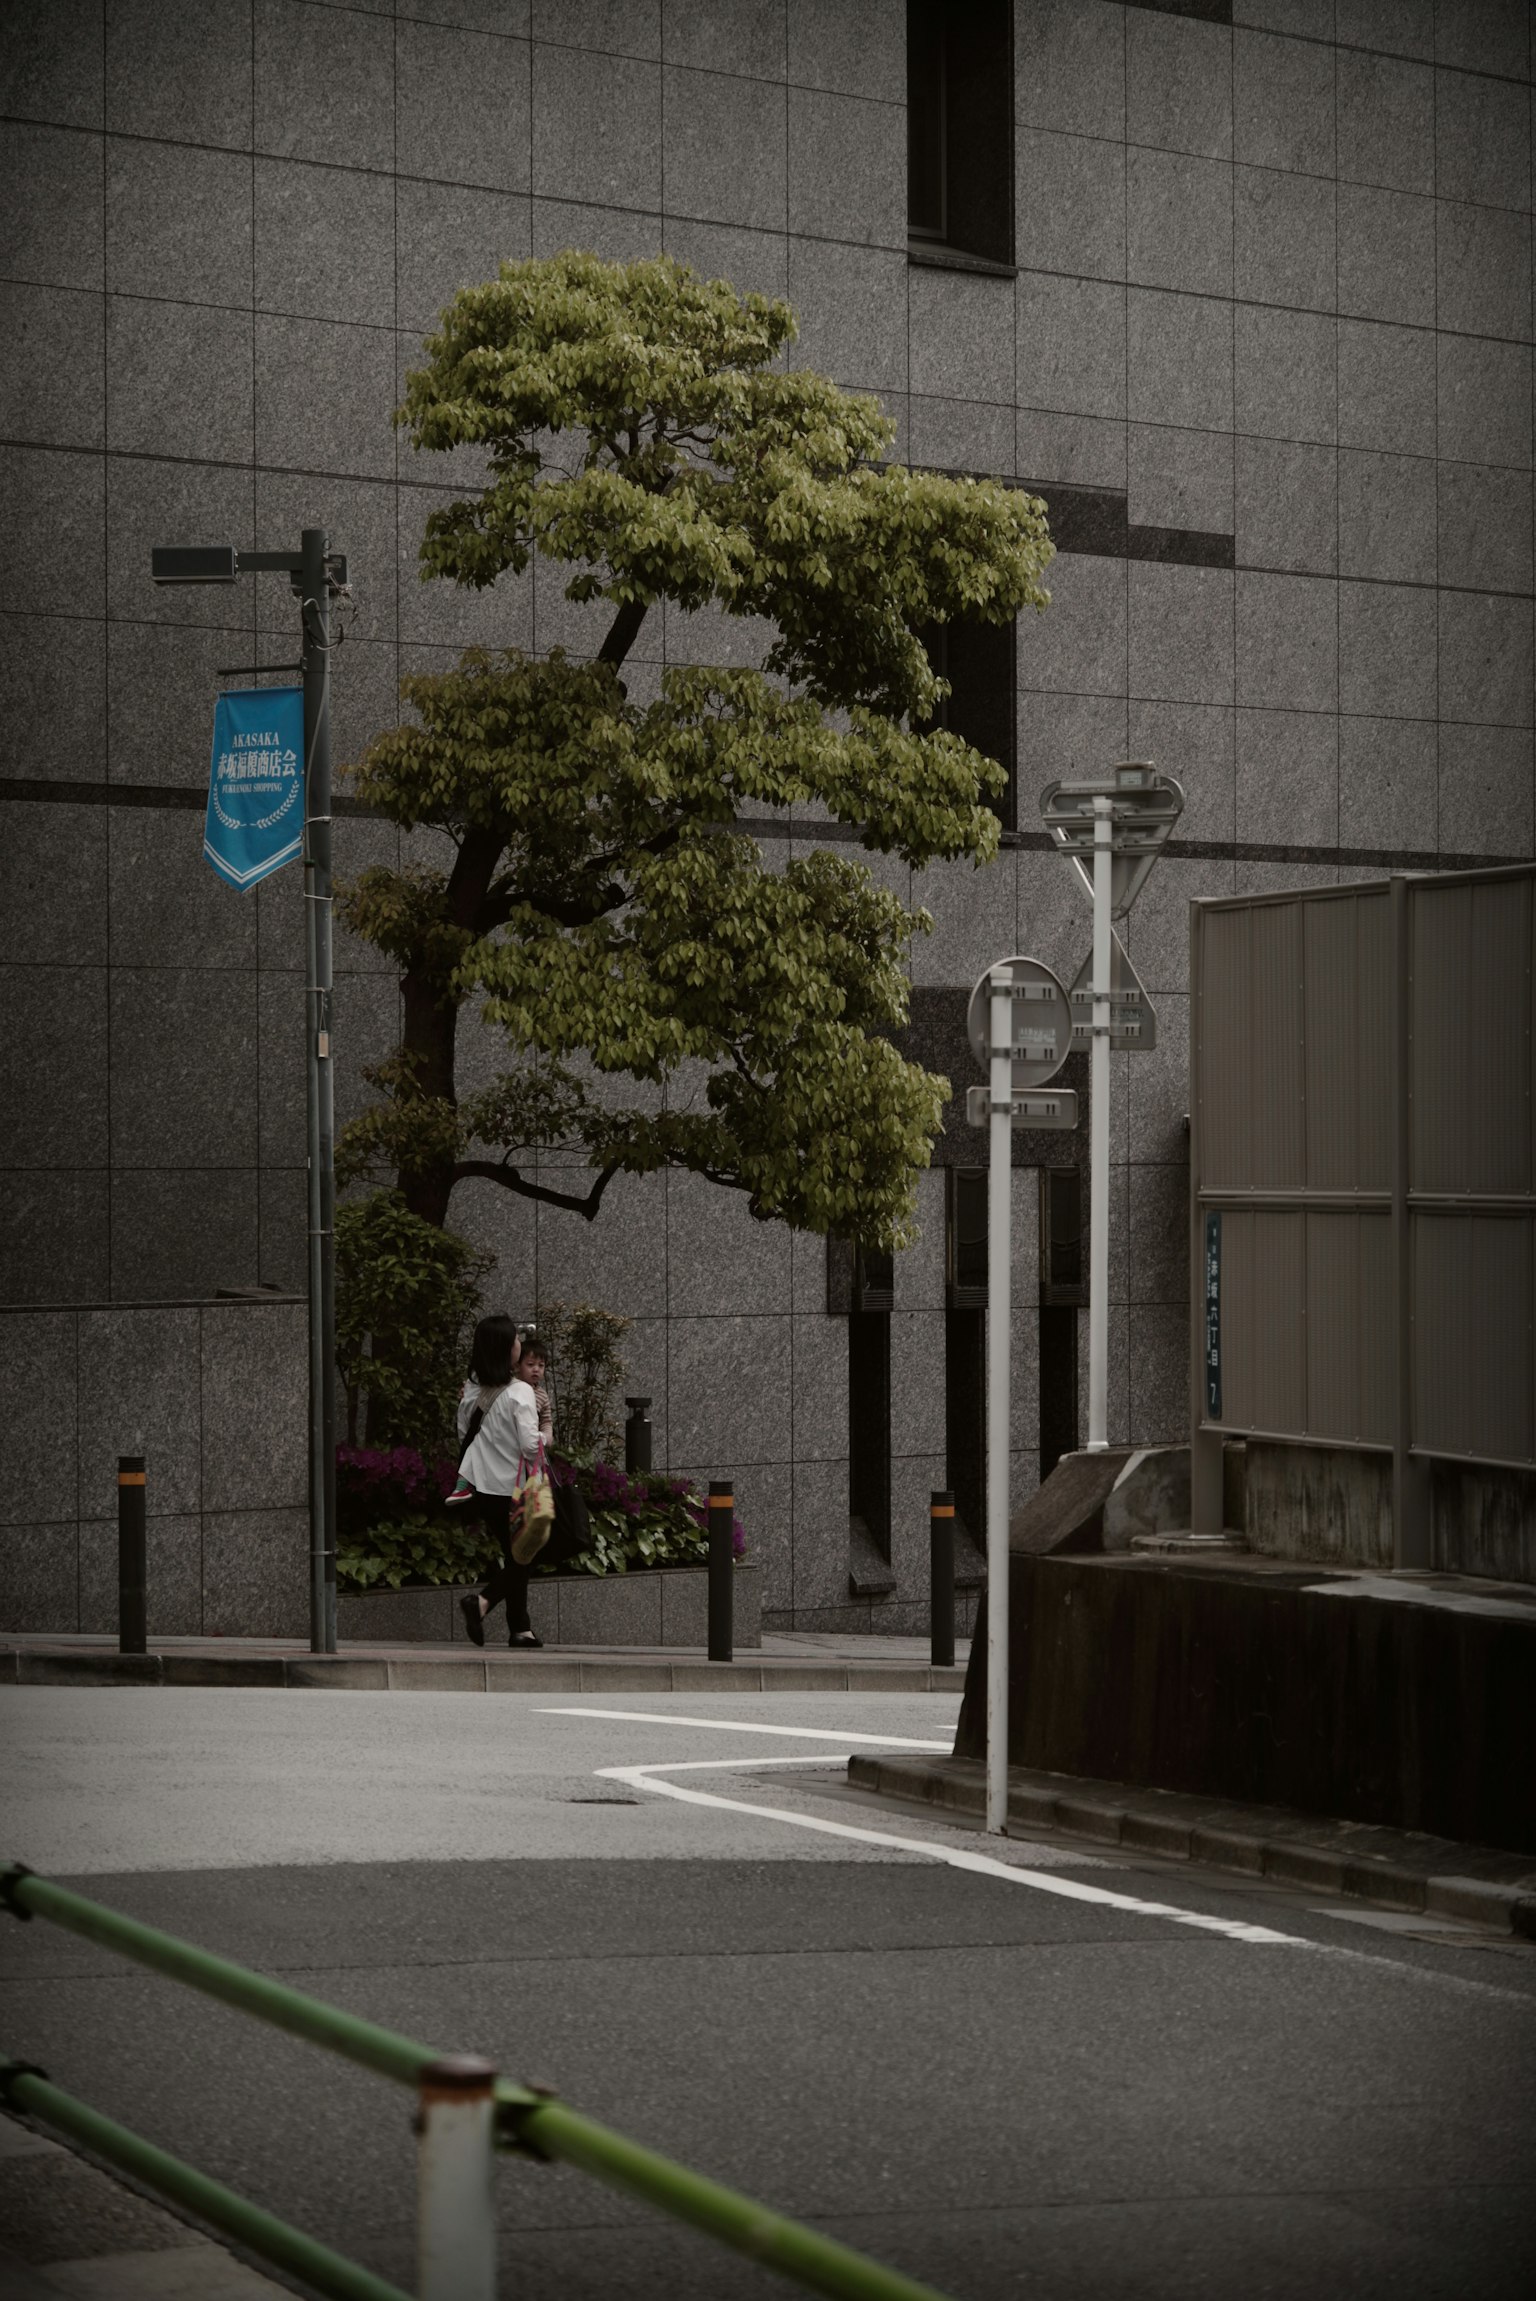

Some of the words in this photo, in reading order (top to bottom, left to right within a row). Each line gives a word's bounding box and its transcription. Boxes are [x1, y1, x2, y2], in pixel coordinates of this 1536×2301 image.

[232, 732, 280, 748] AKASAKA
[253, 782, 282, 792] SHOPPING
[1210, 1382, 1217, 1405] 7
